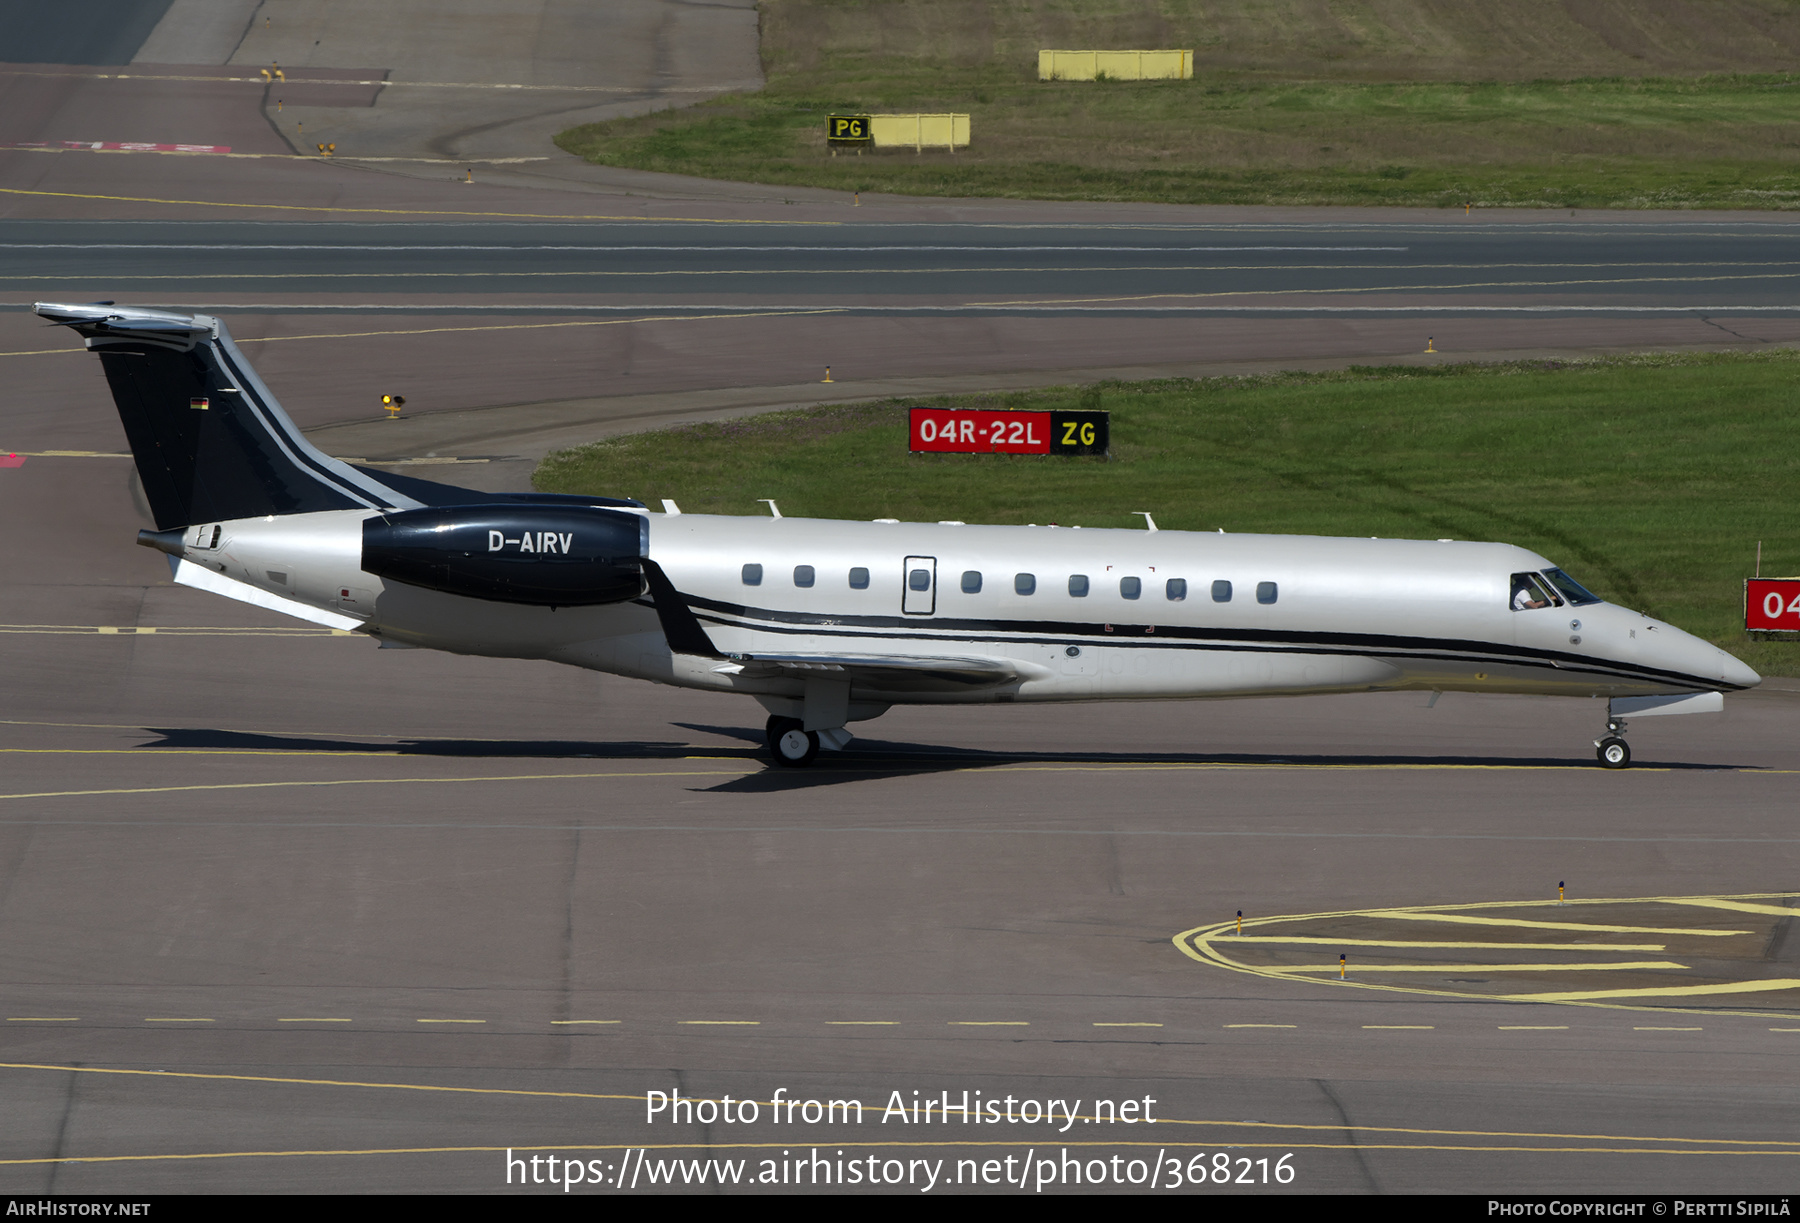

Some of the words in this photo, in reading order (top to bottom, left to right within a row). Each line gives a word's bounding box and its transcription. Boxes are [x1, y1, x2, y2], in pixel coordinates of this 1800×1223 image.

[836, 119, 861, 136] PG
[920, 419, 1042, 445] 04R-22L
[1061, 422, 1095, 446] ZG
[488, 530, 573, 554] D-AIRV
